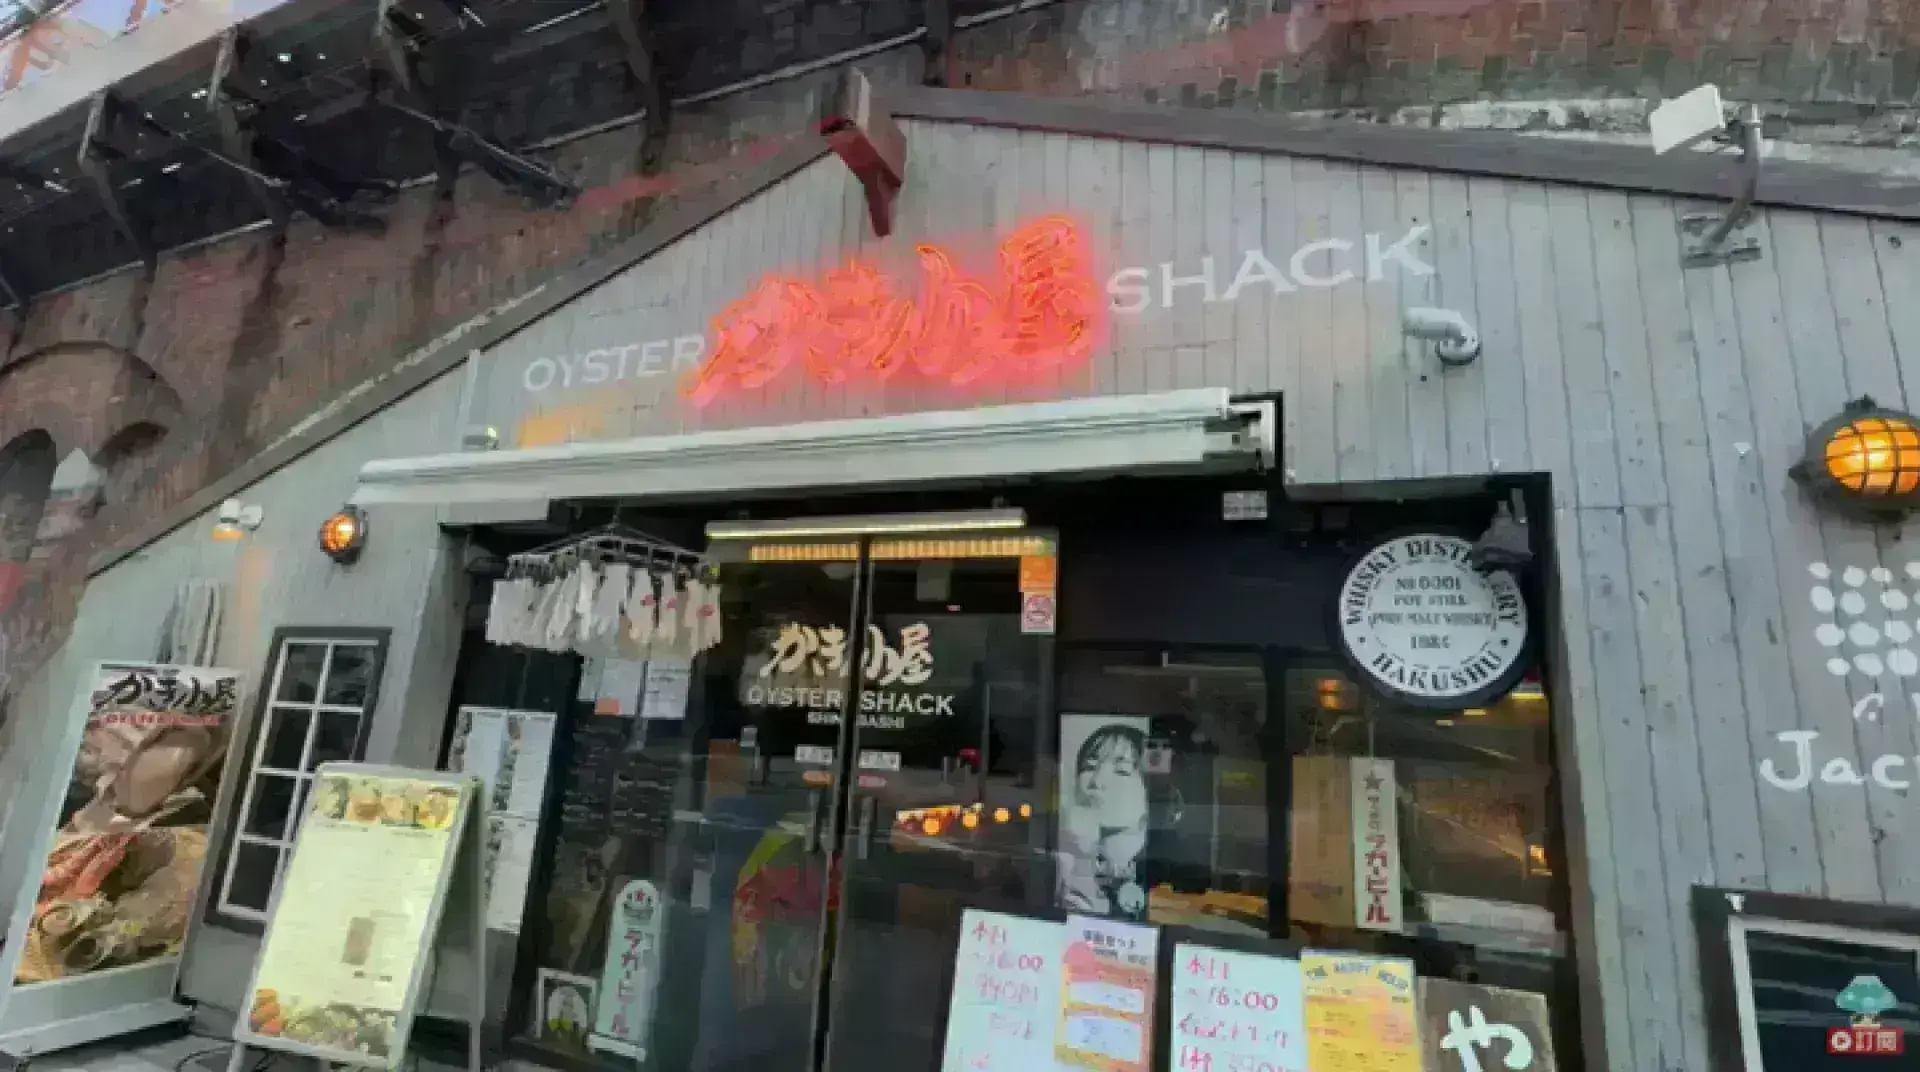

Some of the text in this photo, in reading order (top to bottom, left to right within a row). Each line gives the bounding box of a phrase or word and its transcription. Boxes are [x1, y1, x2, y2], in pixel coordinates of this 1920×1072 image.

[523, 223, 1435, 391] OYSTER SHACK
[1346, 545, 1396, 625] WHISKY
[748, 684, 955, 716] OYSTER SHACK
[1372, 650, 1502, 692] HAKUSHU
[1759, 730, 1920, 793] Jac
